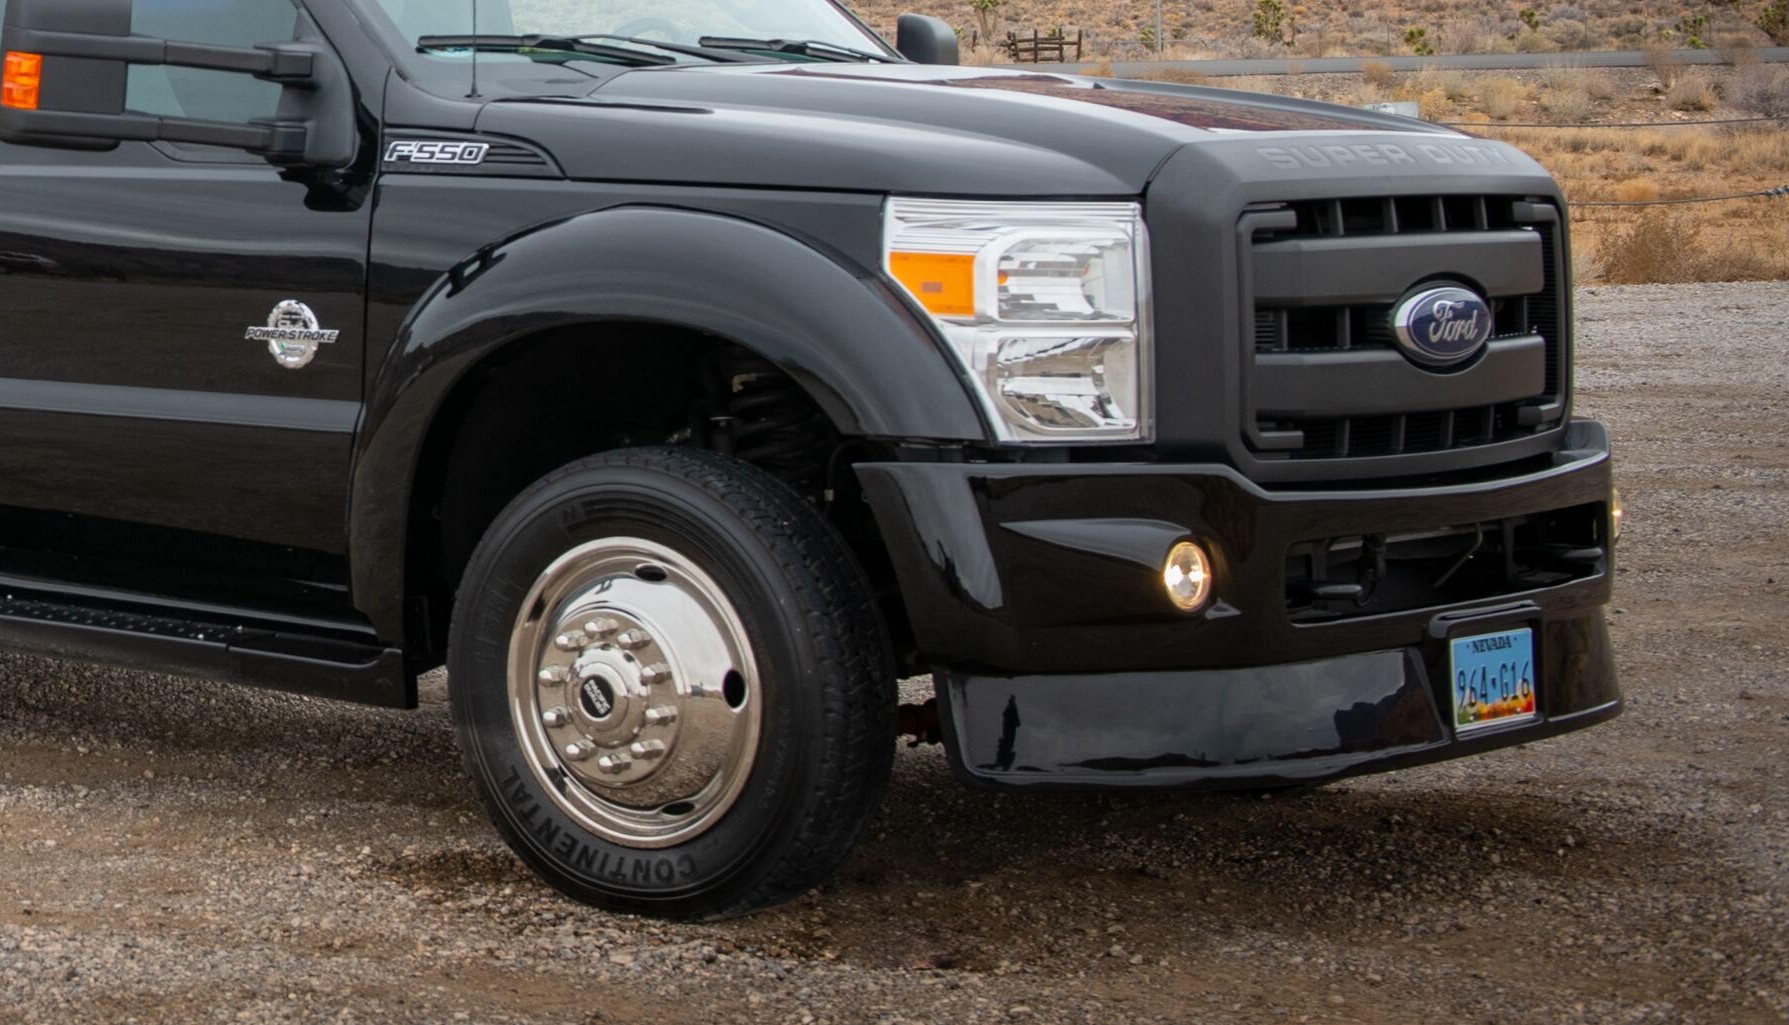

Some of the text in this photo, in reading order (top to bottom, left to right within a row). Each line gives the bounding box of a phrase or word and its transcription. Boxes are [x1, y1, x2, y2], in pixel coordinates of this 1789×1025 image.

[1255, 143, 1512, 169] SUPER DUTY
[244, 325, 340, 344] POWER STROKE
[1428, 299, 1479, 344] Ford
[1471, 635, 1513, 654] NEVADA
[499, 765, 700, 885] CONTINENTAL
